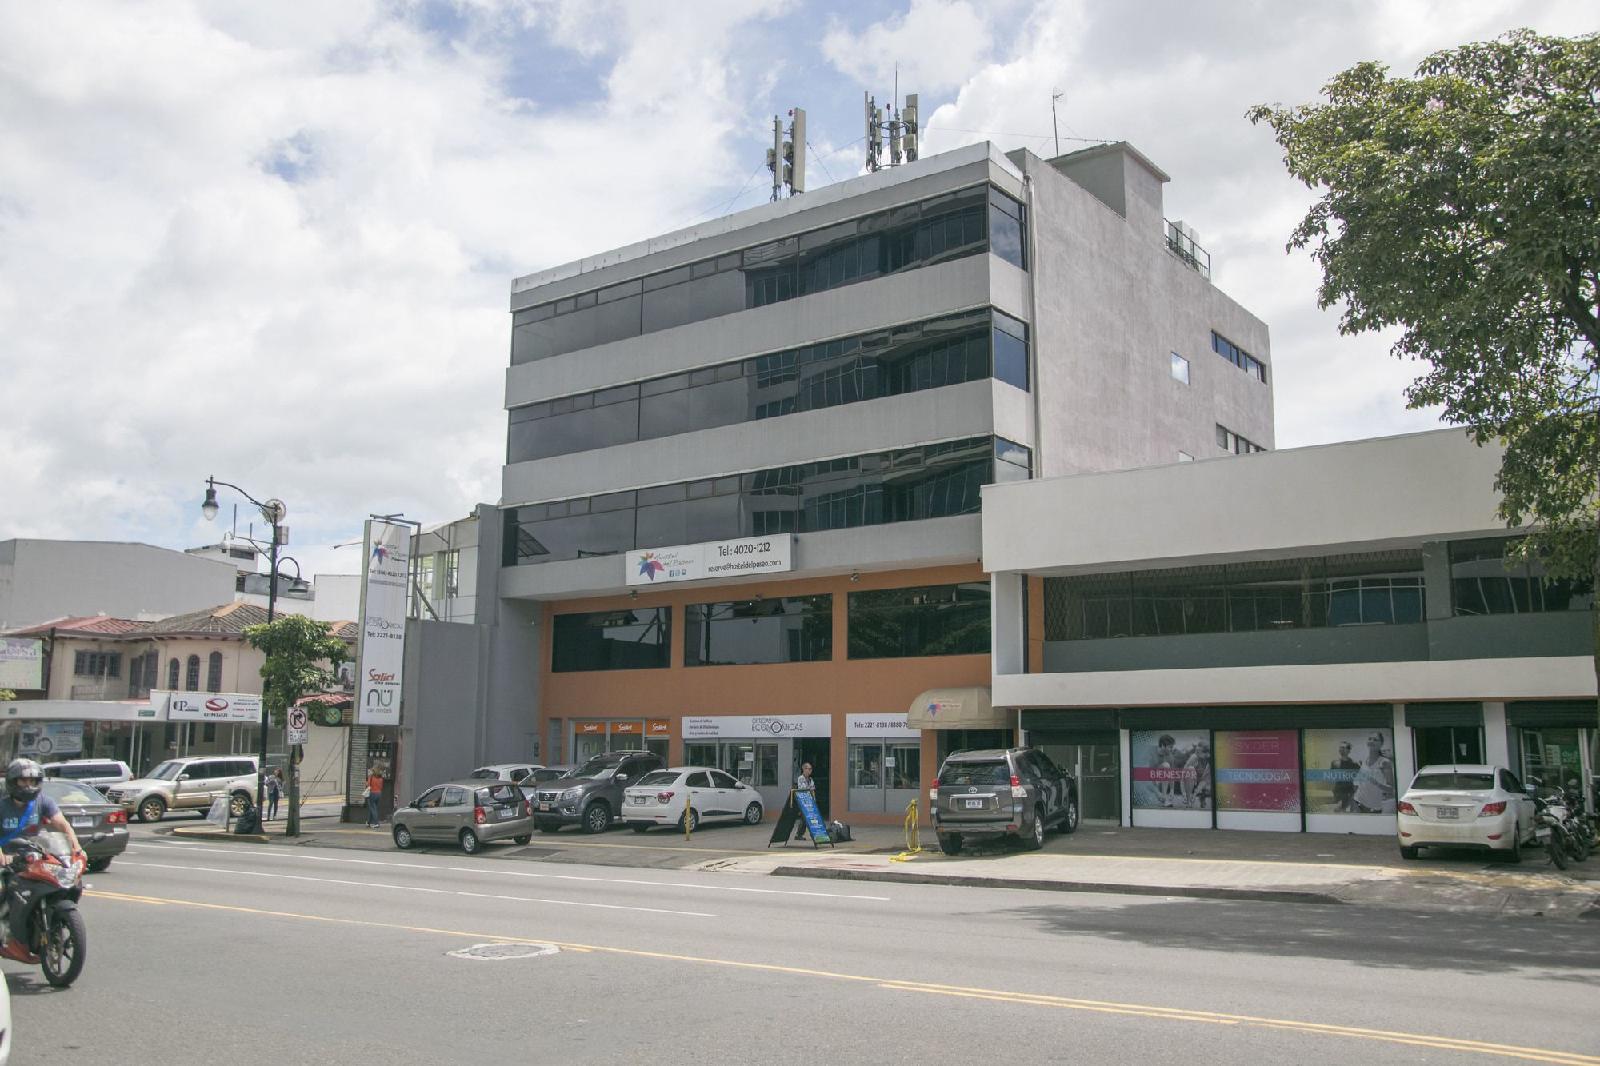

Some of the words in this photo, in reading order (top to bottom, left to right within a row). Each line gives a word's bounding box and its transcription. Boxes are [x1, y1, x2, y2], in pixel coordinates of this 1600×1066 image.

[717, 545, 733, 557] Tel:
[1150, 770, 1197, 779] BIENESTAR
[1229, 769, 1291, 781] TECNOLOGÍA
